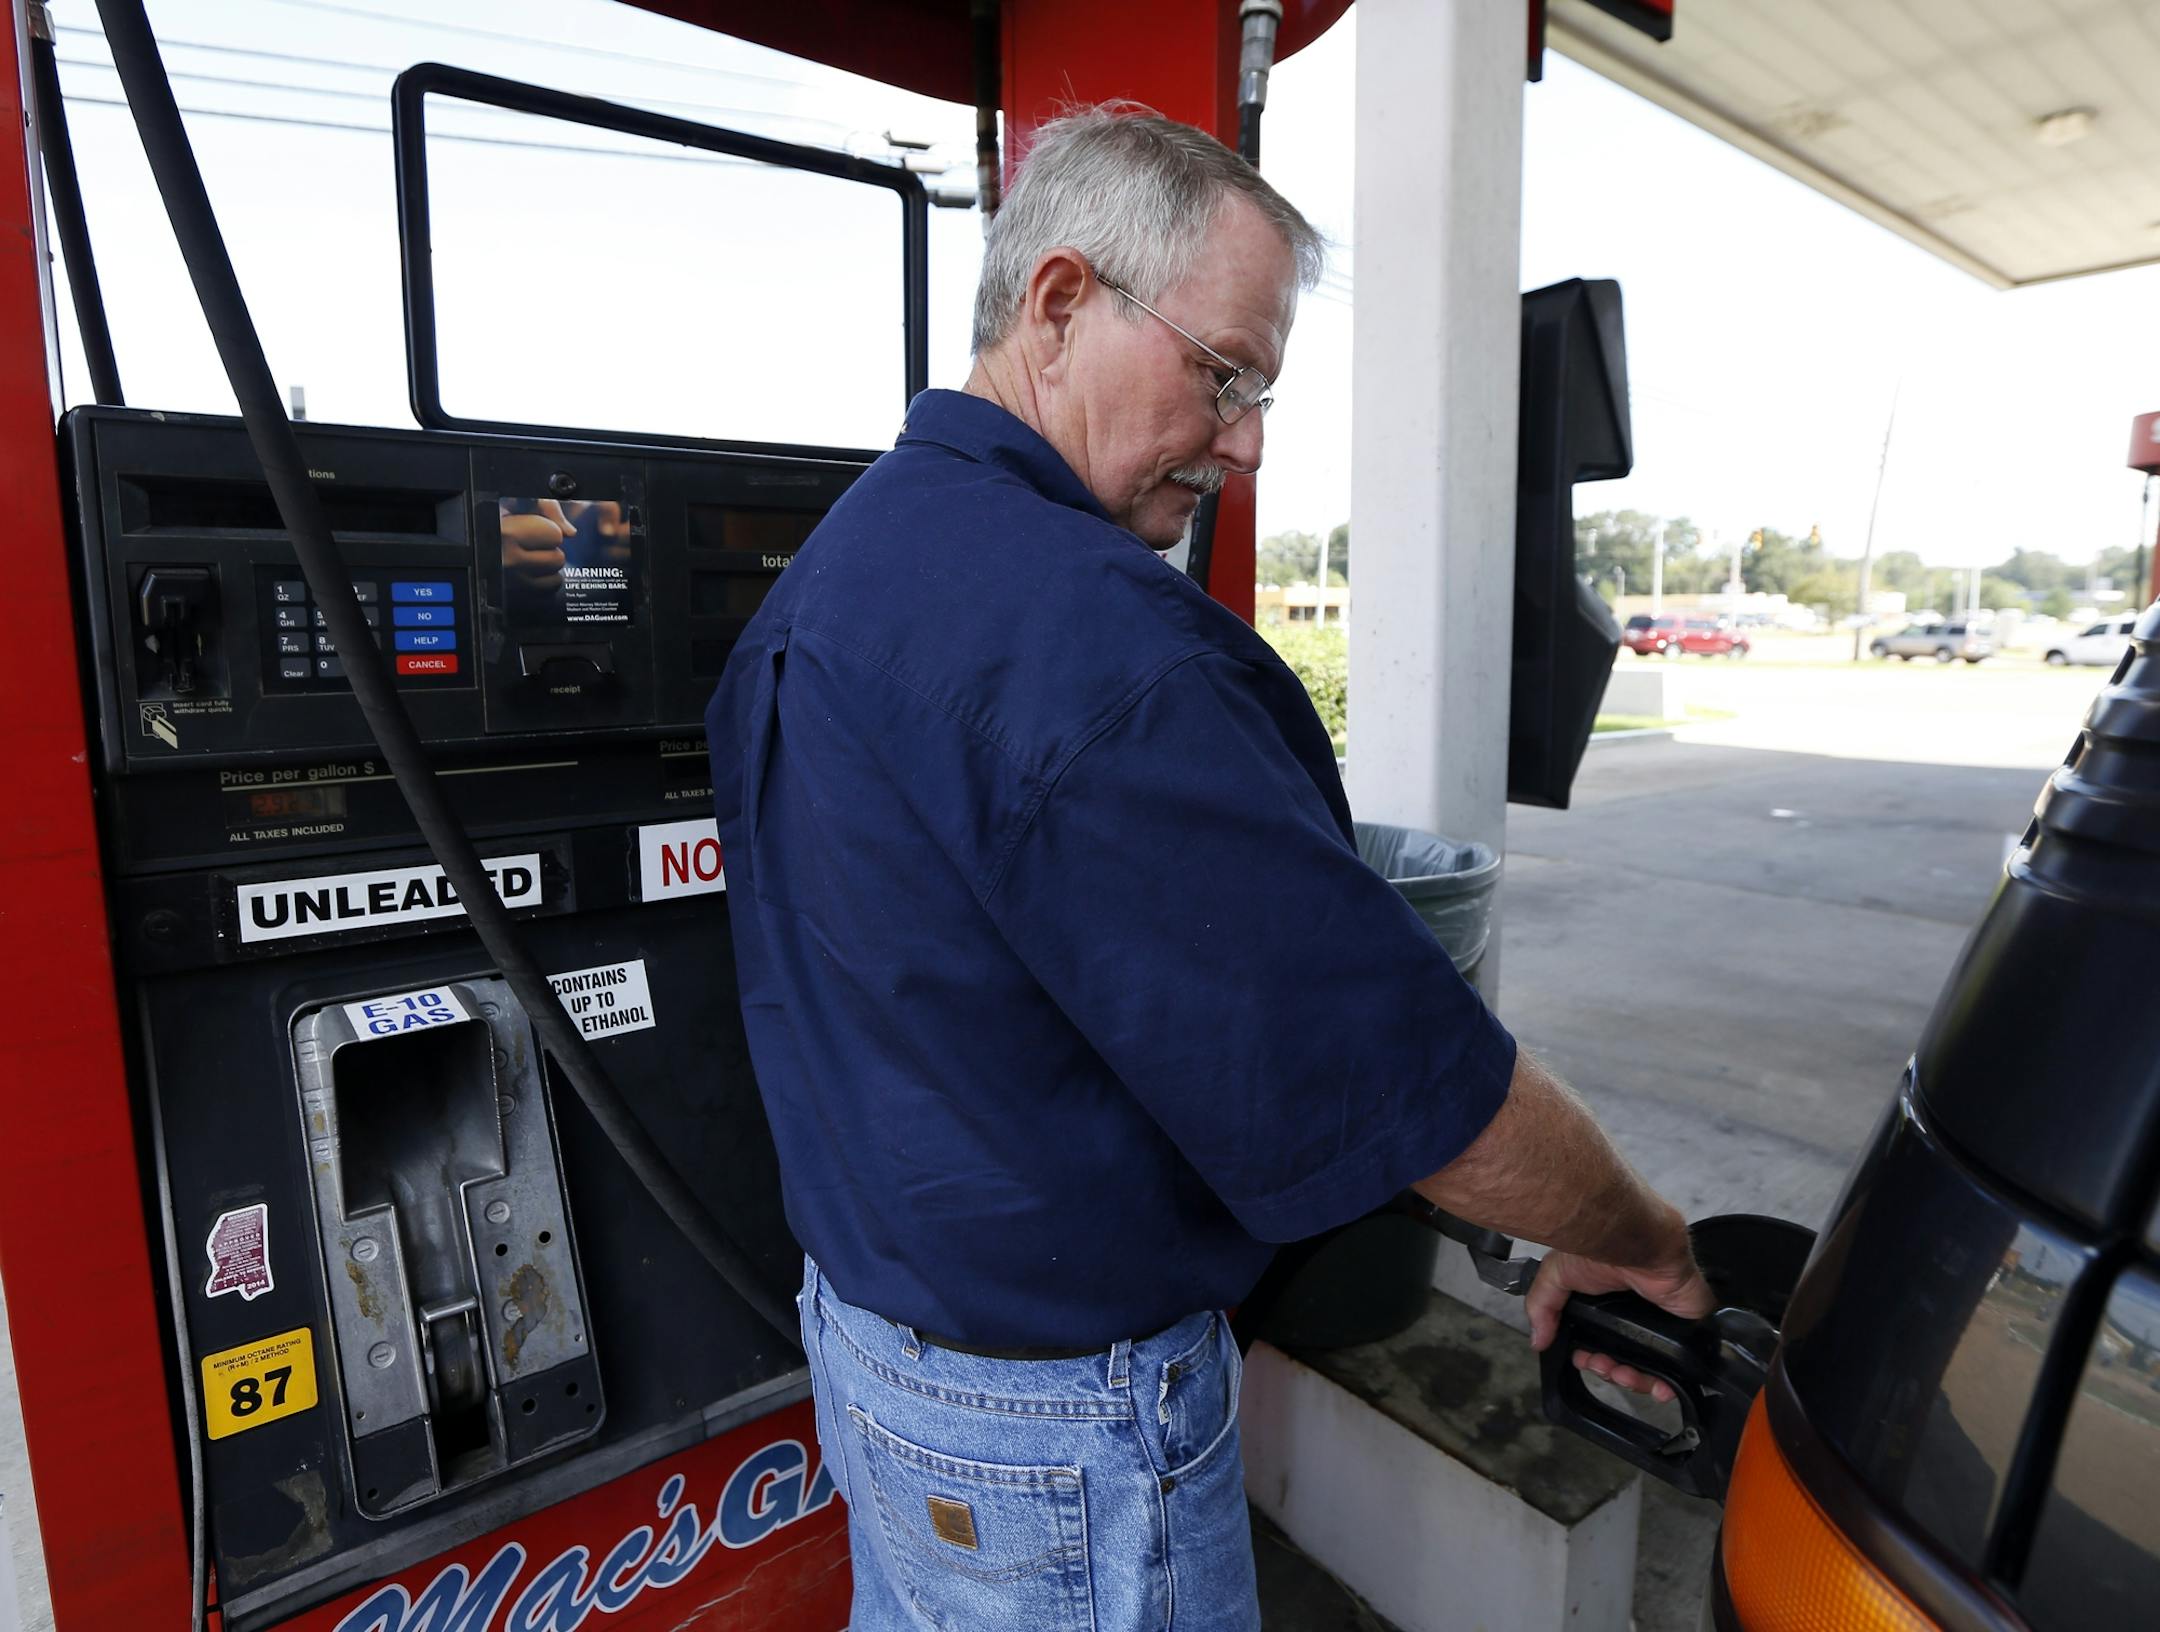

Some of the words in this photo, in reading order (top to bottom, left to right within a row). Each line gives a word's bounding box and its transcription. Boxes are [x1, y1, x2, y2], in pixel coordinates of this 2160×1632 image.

[564, 567, 623, 578] WARNING:
[413, 588, 433, 597] YES
[279, 611, 287, 619] 4
[417, 612, 432, 621] NO
[281, 637, 288, 645] 7
[318, 637, 326, 645] 8
[414, 636, 439, 645] HELP
[408, 660, 447, 669] CANCEL
[283, 669, 304, 678] Clear
[550, 685, 581, 695] receipt
[659, 740, 690, 752] Price
[220, 771, 265, 785] Price
[272, 769, 301, 783] per
[308, 764, 357, 780] gallon
[664, 792, 678, 800] ALL
[681, 788, 705, 798] TAXES
[229, 833, 250, 842] ALL
[254, 828, 288, 840] TAXES
[291, 823, 345, 837] INCLUDED
[661, 838, 723, 887] NO
[551, 967, 627, 996] CONTAINS
[362, 993, 442, 1019] E-10
[571, 996, 591, 1014] UP
[595, 991, 615, 1009] TO
[368, 1007, 455, 1035] GAS
[581, 1006, 649, 1034] ETHANOL
[246, 1279, 266, 1290] 2014
[213, 1355, 246, 1369] MINIMUM
[247, 1345, 276, 1359] OCTANE
[276, 1338, 302, 1350] RATING
[260, 1348, 290, 1361] METHOD
[230, 1366, 292, 1418] 87
[332, 1473, 717, 1632] Mac's
